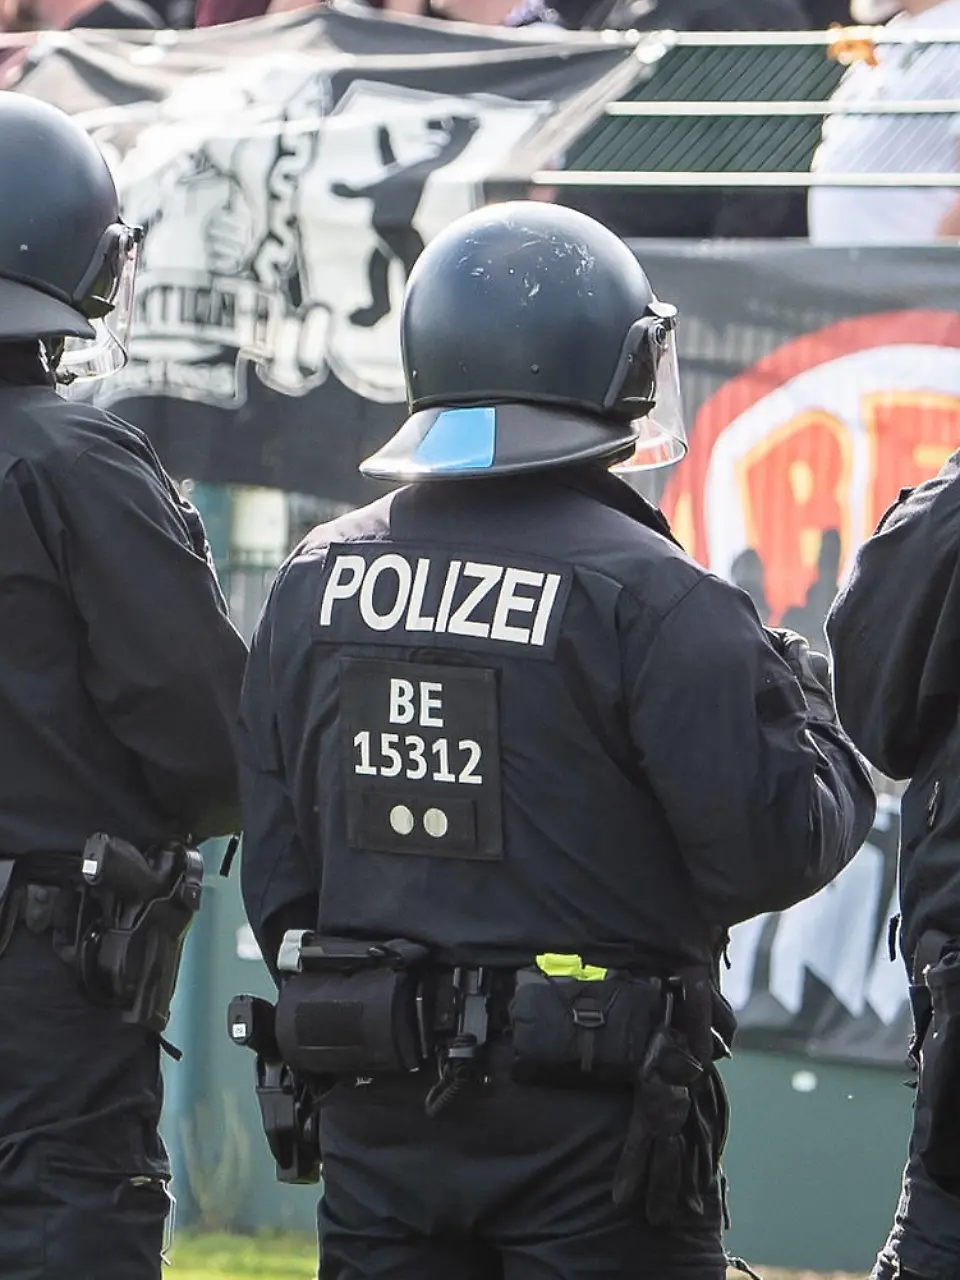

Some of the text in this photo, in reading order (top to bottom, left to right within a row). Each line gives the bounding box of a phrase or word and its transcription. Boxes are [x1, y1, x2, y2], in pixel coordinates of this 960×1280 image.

[320, 554, 561, 646] POLIZEI
[390, 678, 444, 727] BE
[353, 731, 483, 784] 15312
